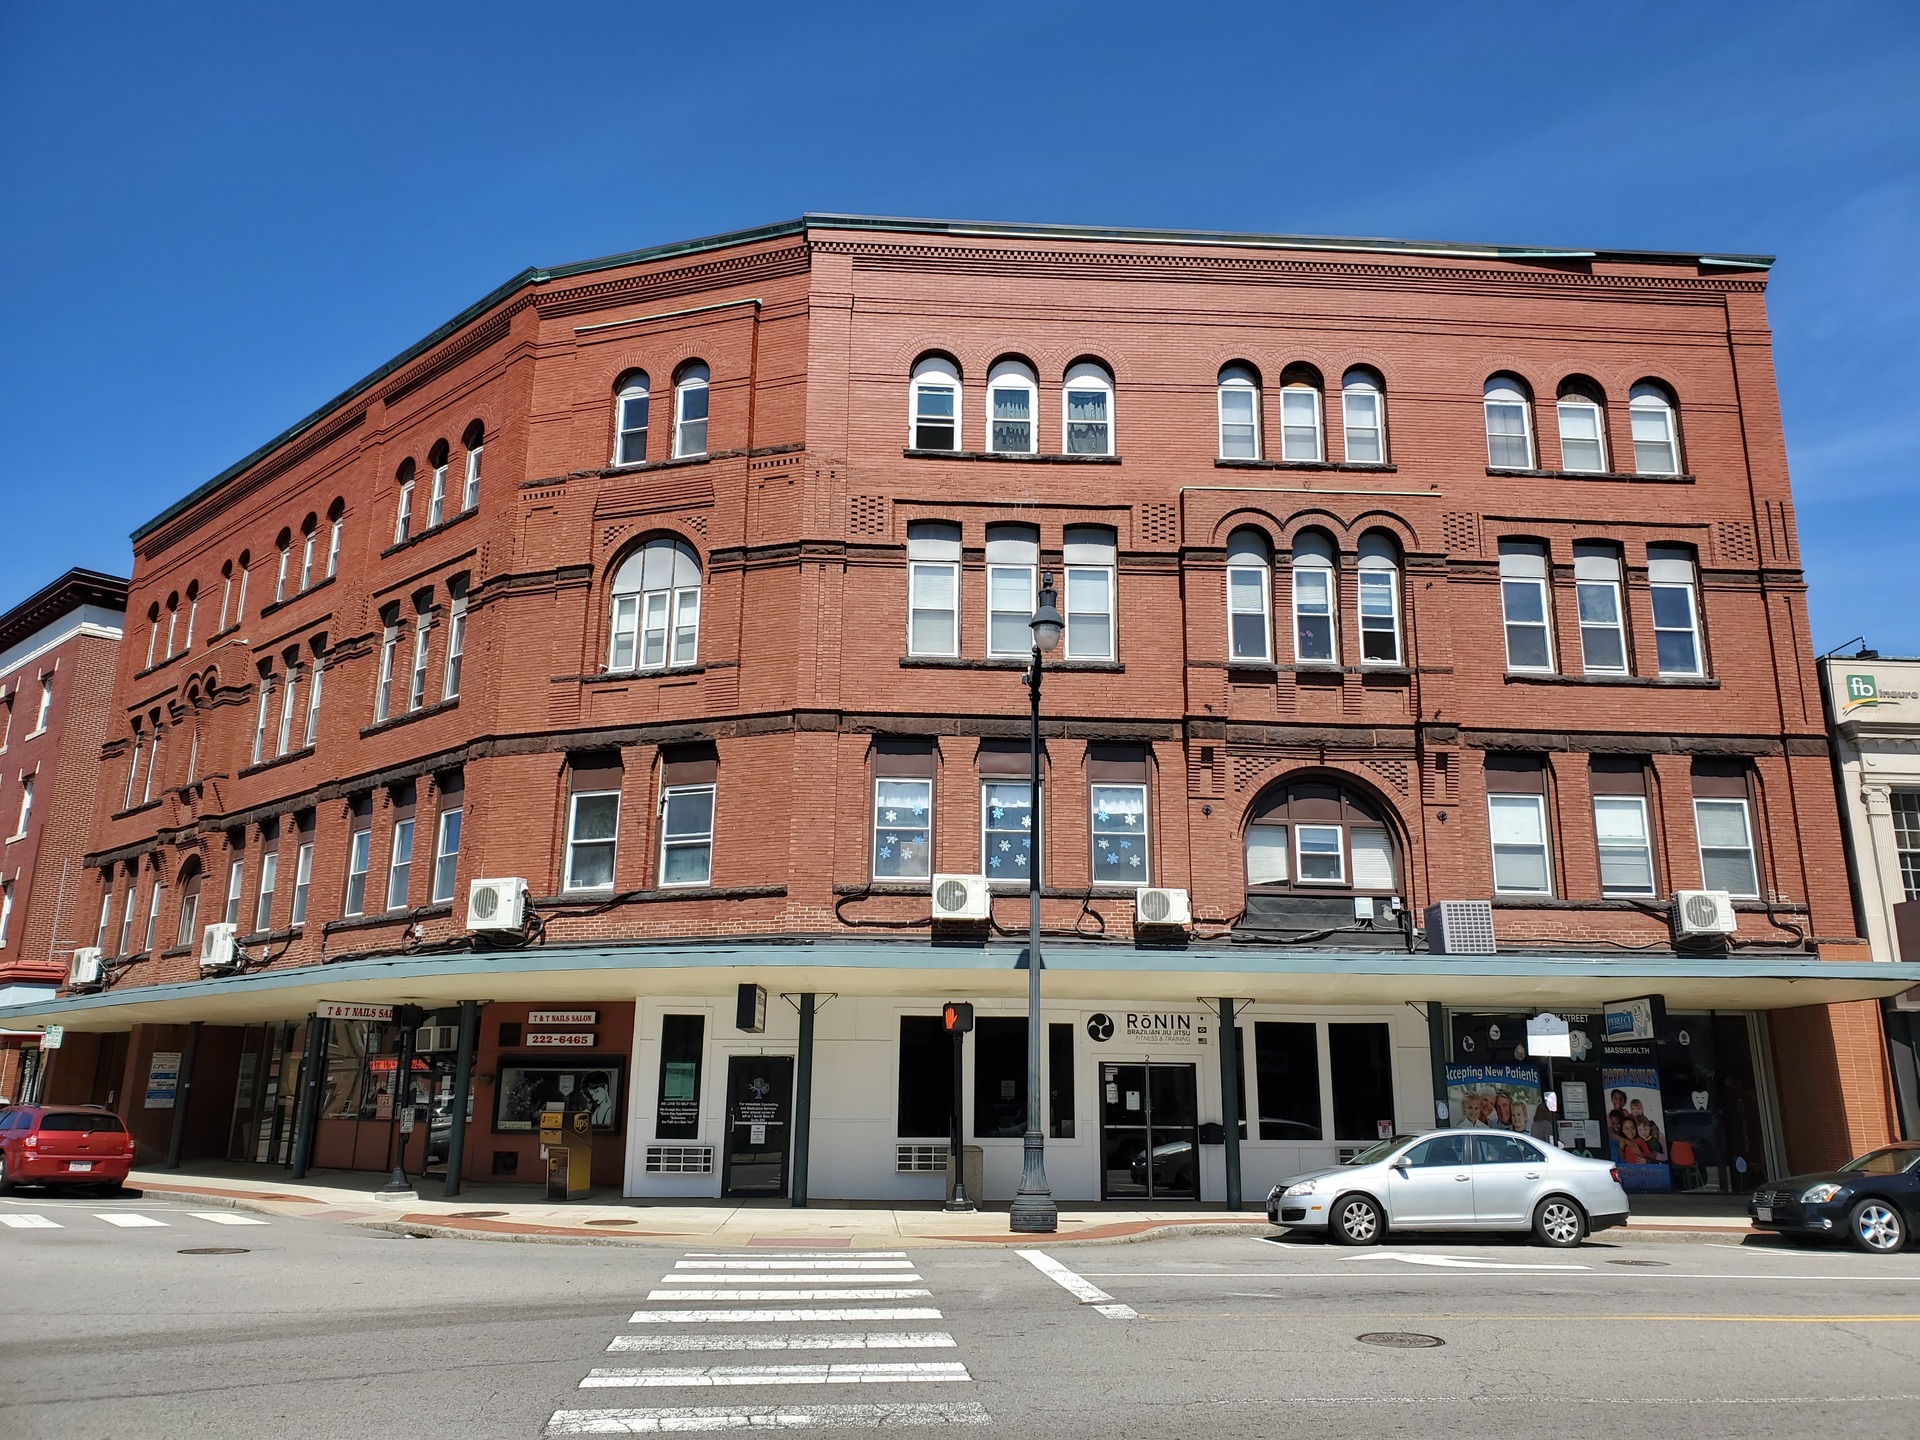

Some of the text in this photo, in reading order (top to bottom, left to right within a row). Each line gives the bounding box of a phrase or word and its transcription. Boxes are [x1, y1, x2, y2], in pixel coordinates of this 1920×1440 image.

[328, 1006, 393, 1018] T & T NAILS SAL
[1562, 1014, 1588, 1023] STREET
[532, 1036, 588, 1044] 222-6465
[1485, 1066, 1503, 1077] New
[1505, 1066, 1538, 1083] Patients
[575, 1119, 588, 1130] ups
